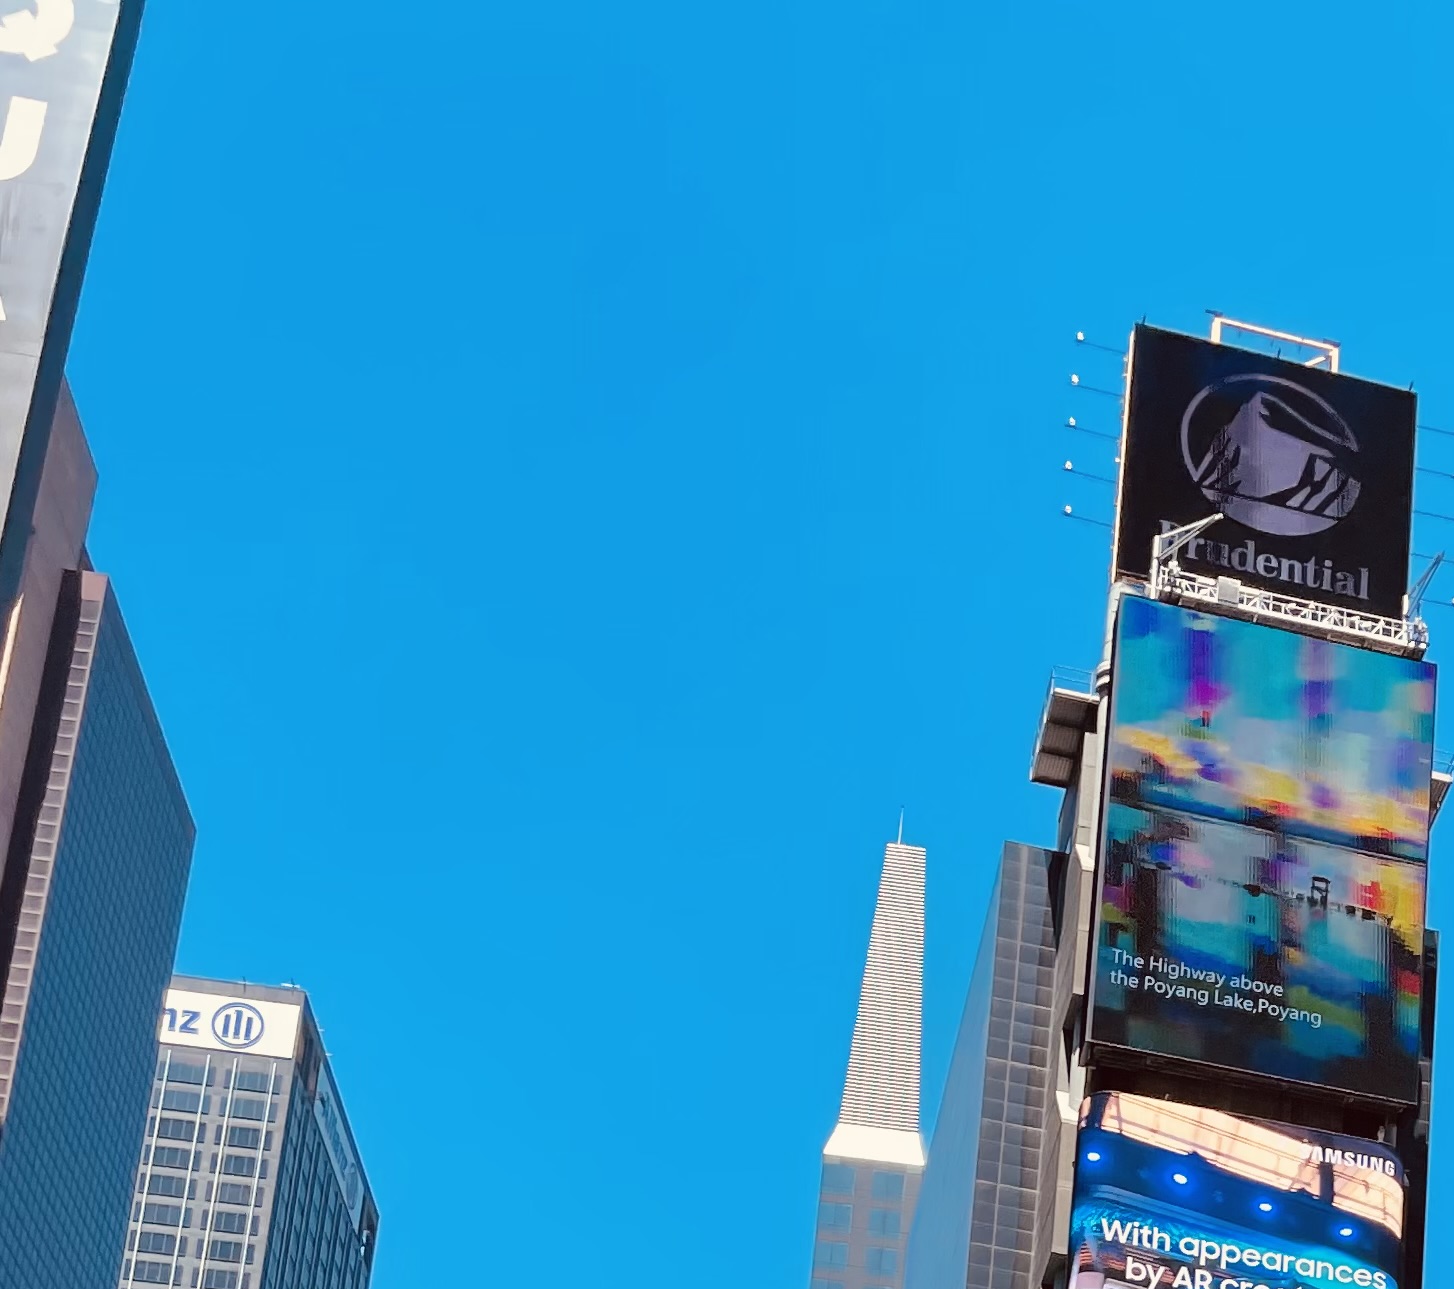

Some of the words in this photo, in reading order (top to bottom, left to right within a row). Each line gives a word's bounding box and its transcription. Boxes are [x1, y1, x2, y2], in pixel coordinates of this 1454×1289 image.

[1159, 519, 1370, 600] Prudential
[1110, 970, 1139, 989] the
[1144, 976, 1209, 1006] Poyang
[1112, 948, 1145, 969] The
[1149, 955, 1226, 985] Highway
[1230, 974, 1284, 997] above
[1101, 1217, 1170, 1252] With
